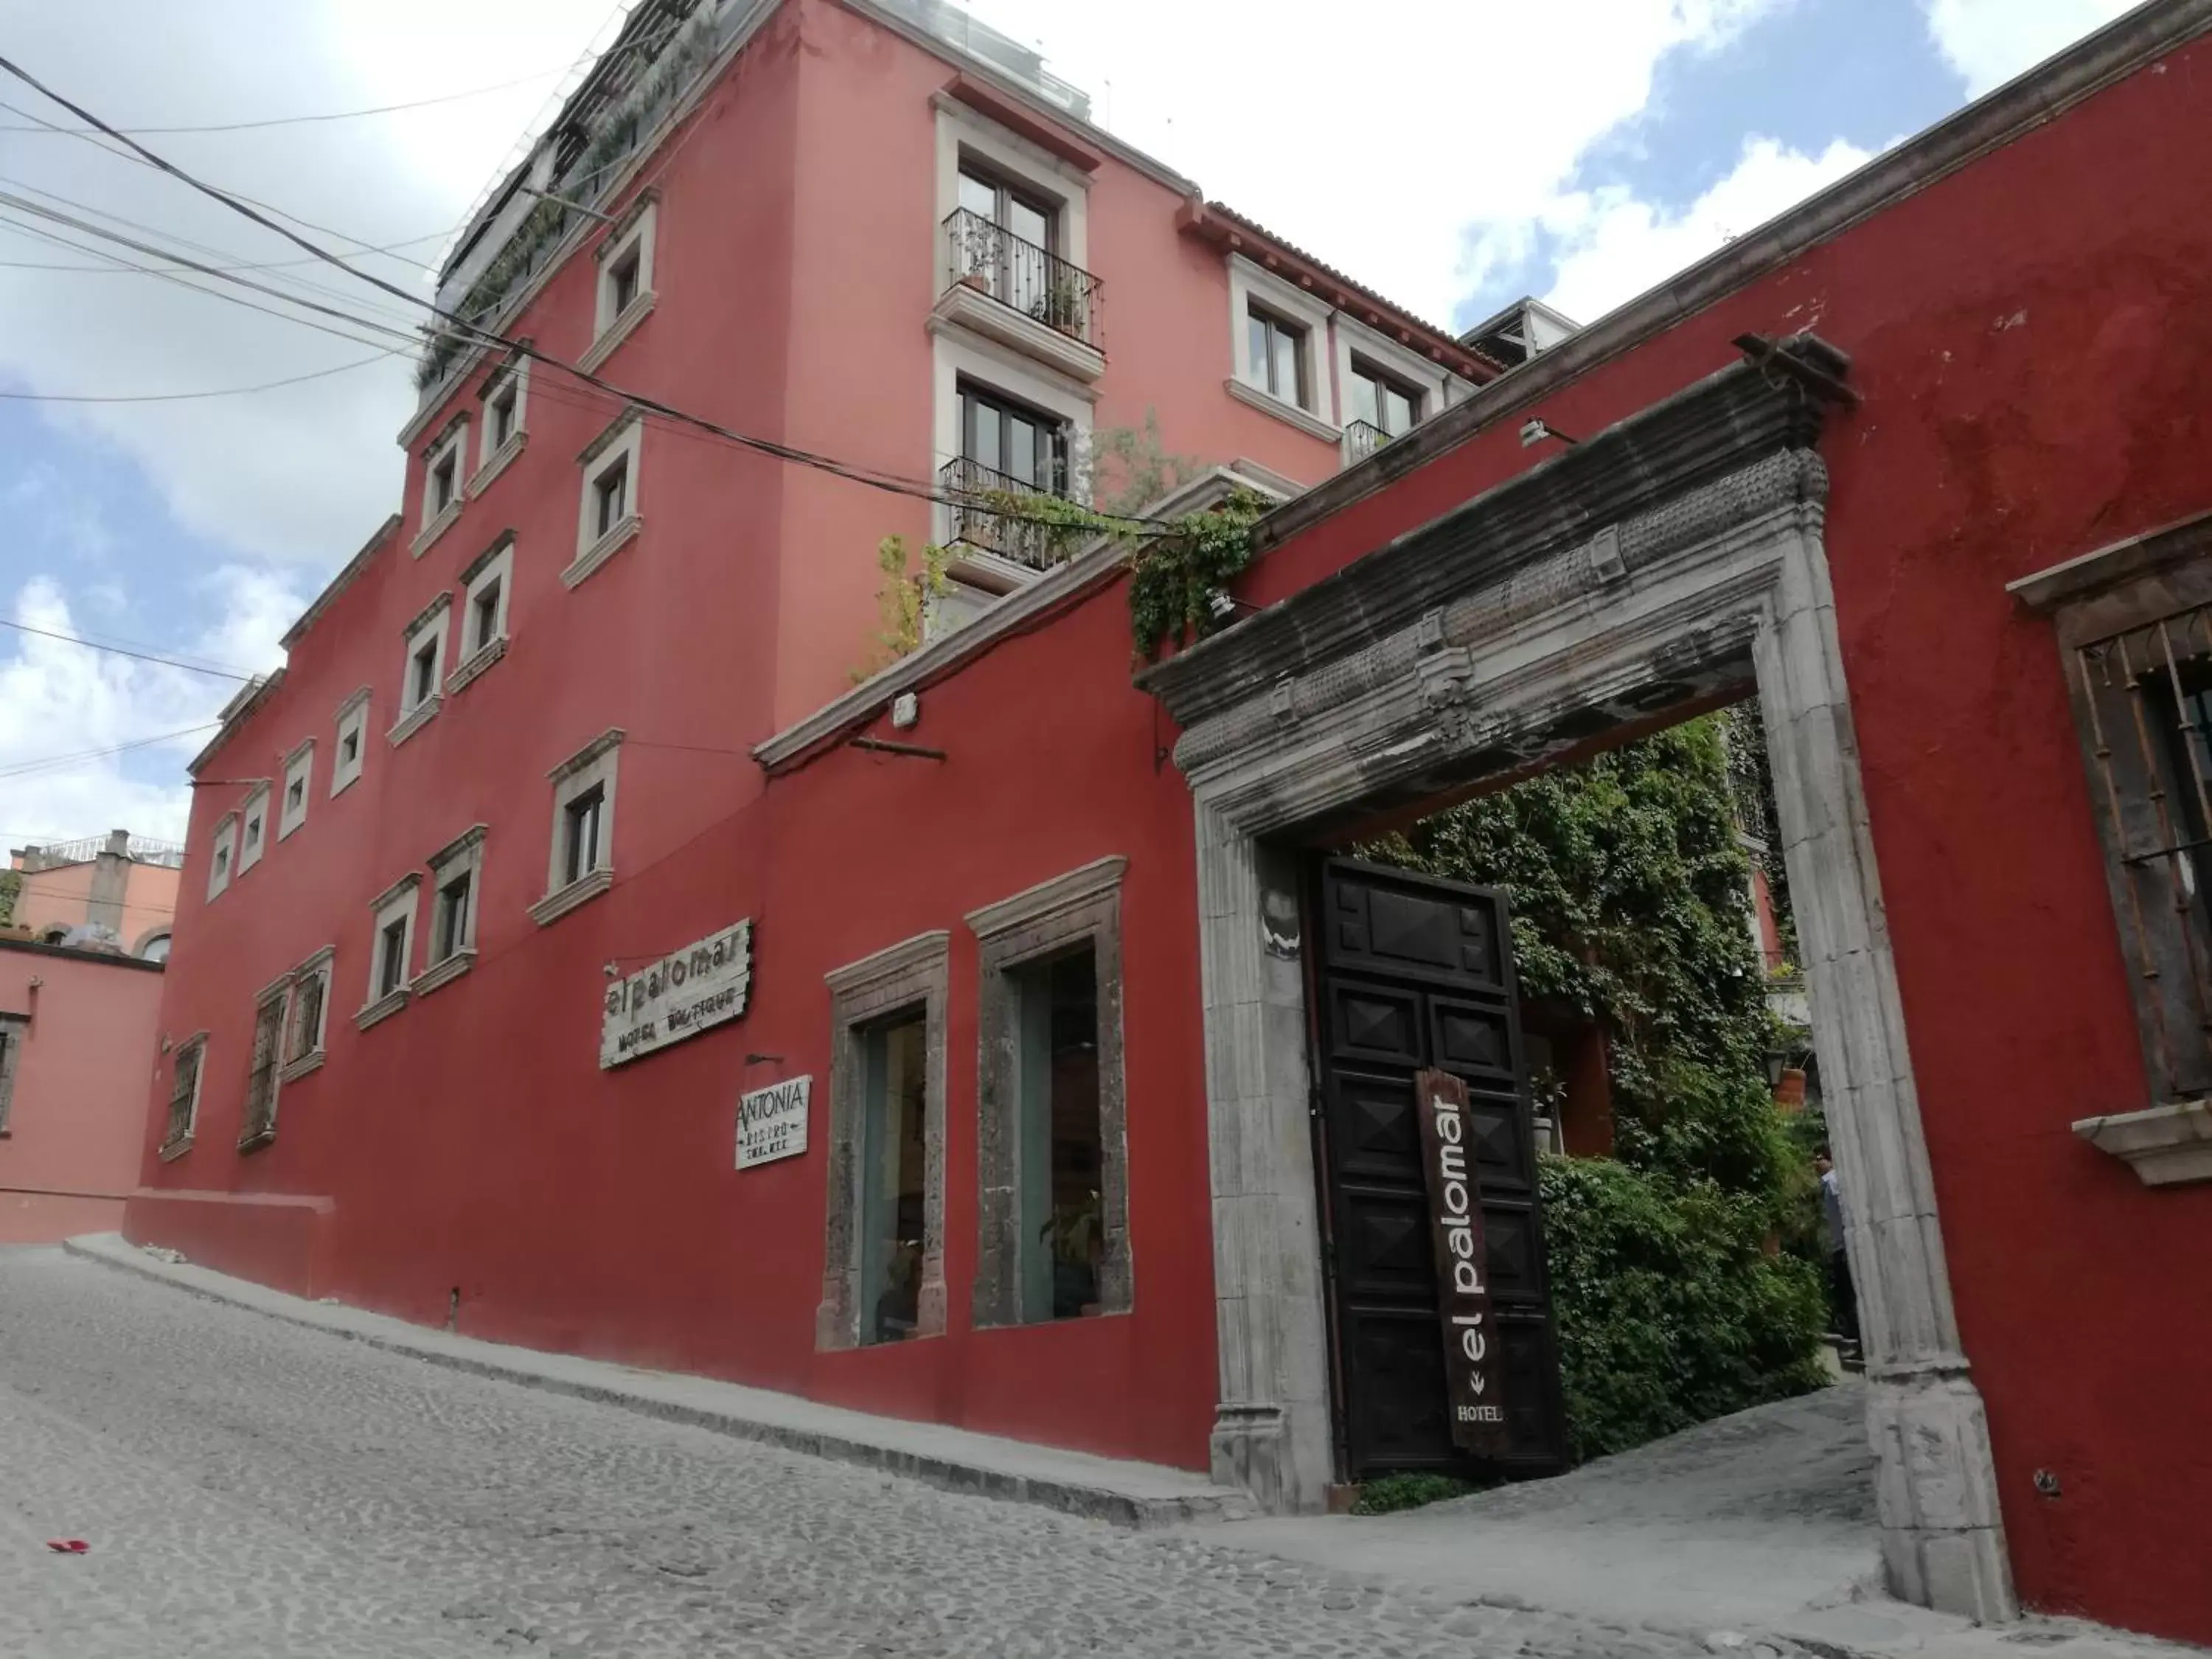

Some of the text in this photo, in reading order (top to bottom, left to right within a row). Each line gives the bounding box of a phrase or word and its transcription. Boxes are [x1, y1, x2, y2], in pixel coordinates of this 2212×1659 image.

[607, 930, 740, 1023] el palomar
[736, 1082, 803, 1132] ANTONIA
[1434, 1094, 1485, 1362] el palomar
[1457, 1405, 1504, 1422] HOTEL
